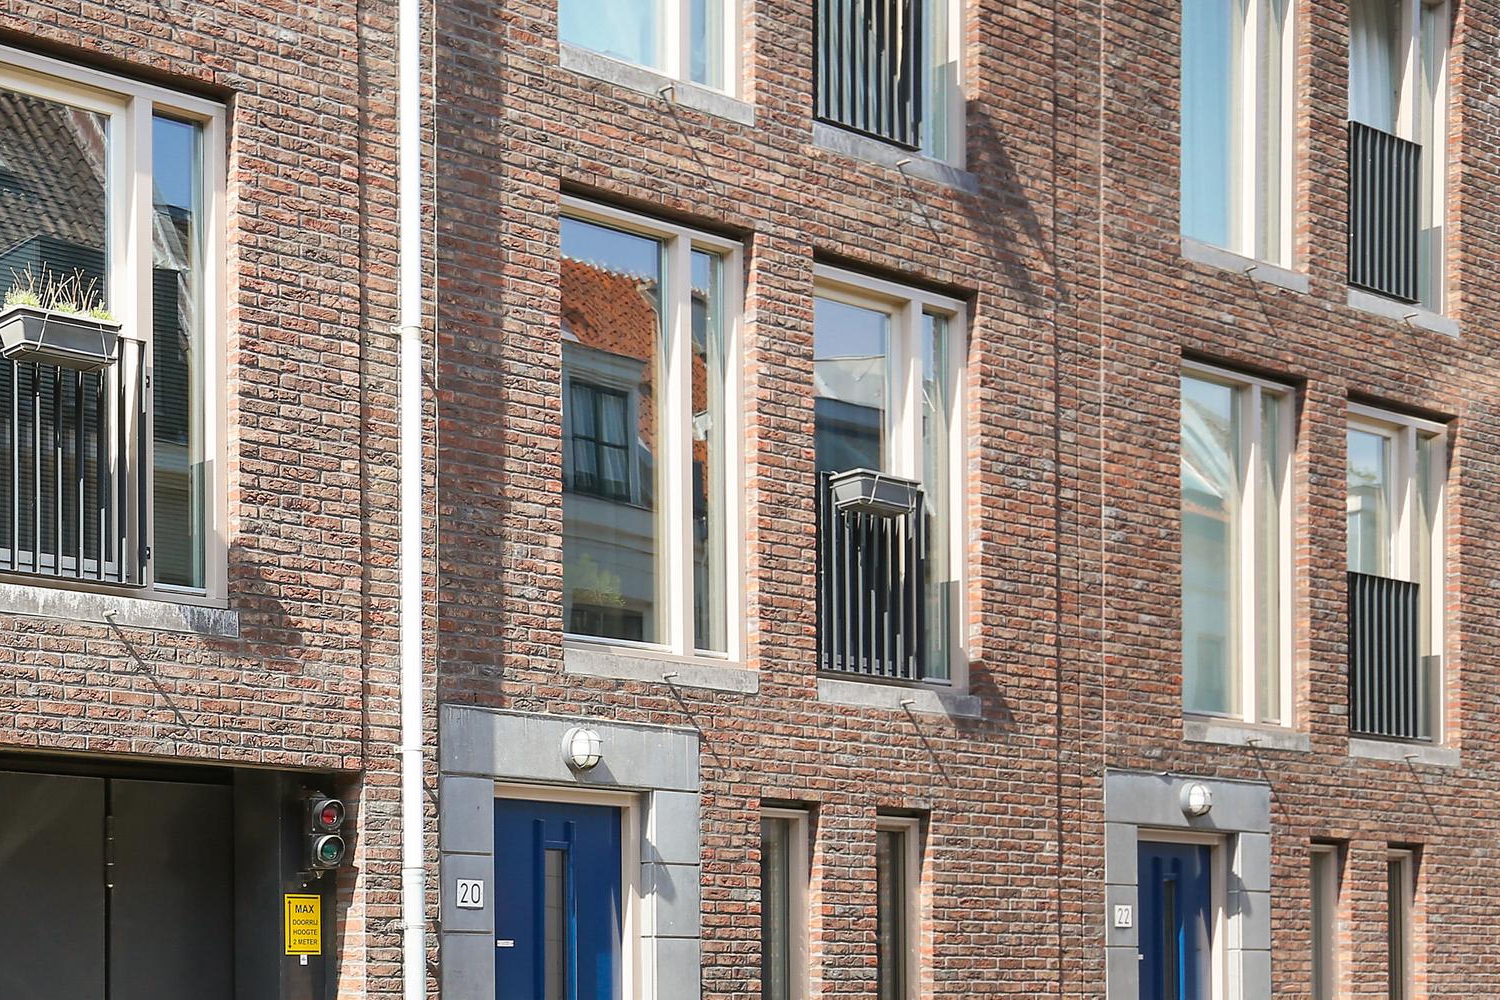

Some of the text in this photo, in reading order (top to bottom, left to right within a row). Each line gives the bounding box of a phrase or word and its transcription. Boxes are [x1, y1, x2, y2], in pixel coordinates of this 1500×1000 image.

[461, 883, 480, 904] 20
[295, 904, 314, 913] MAX
[1117, 907, 1130, 925] 22
